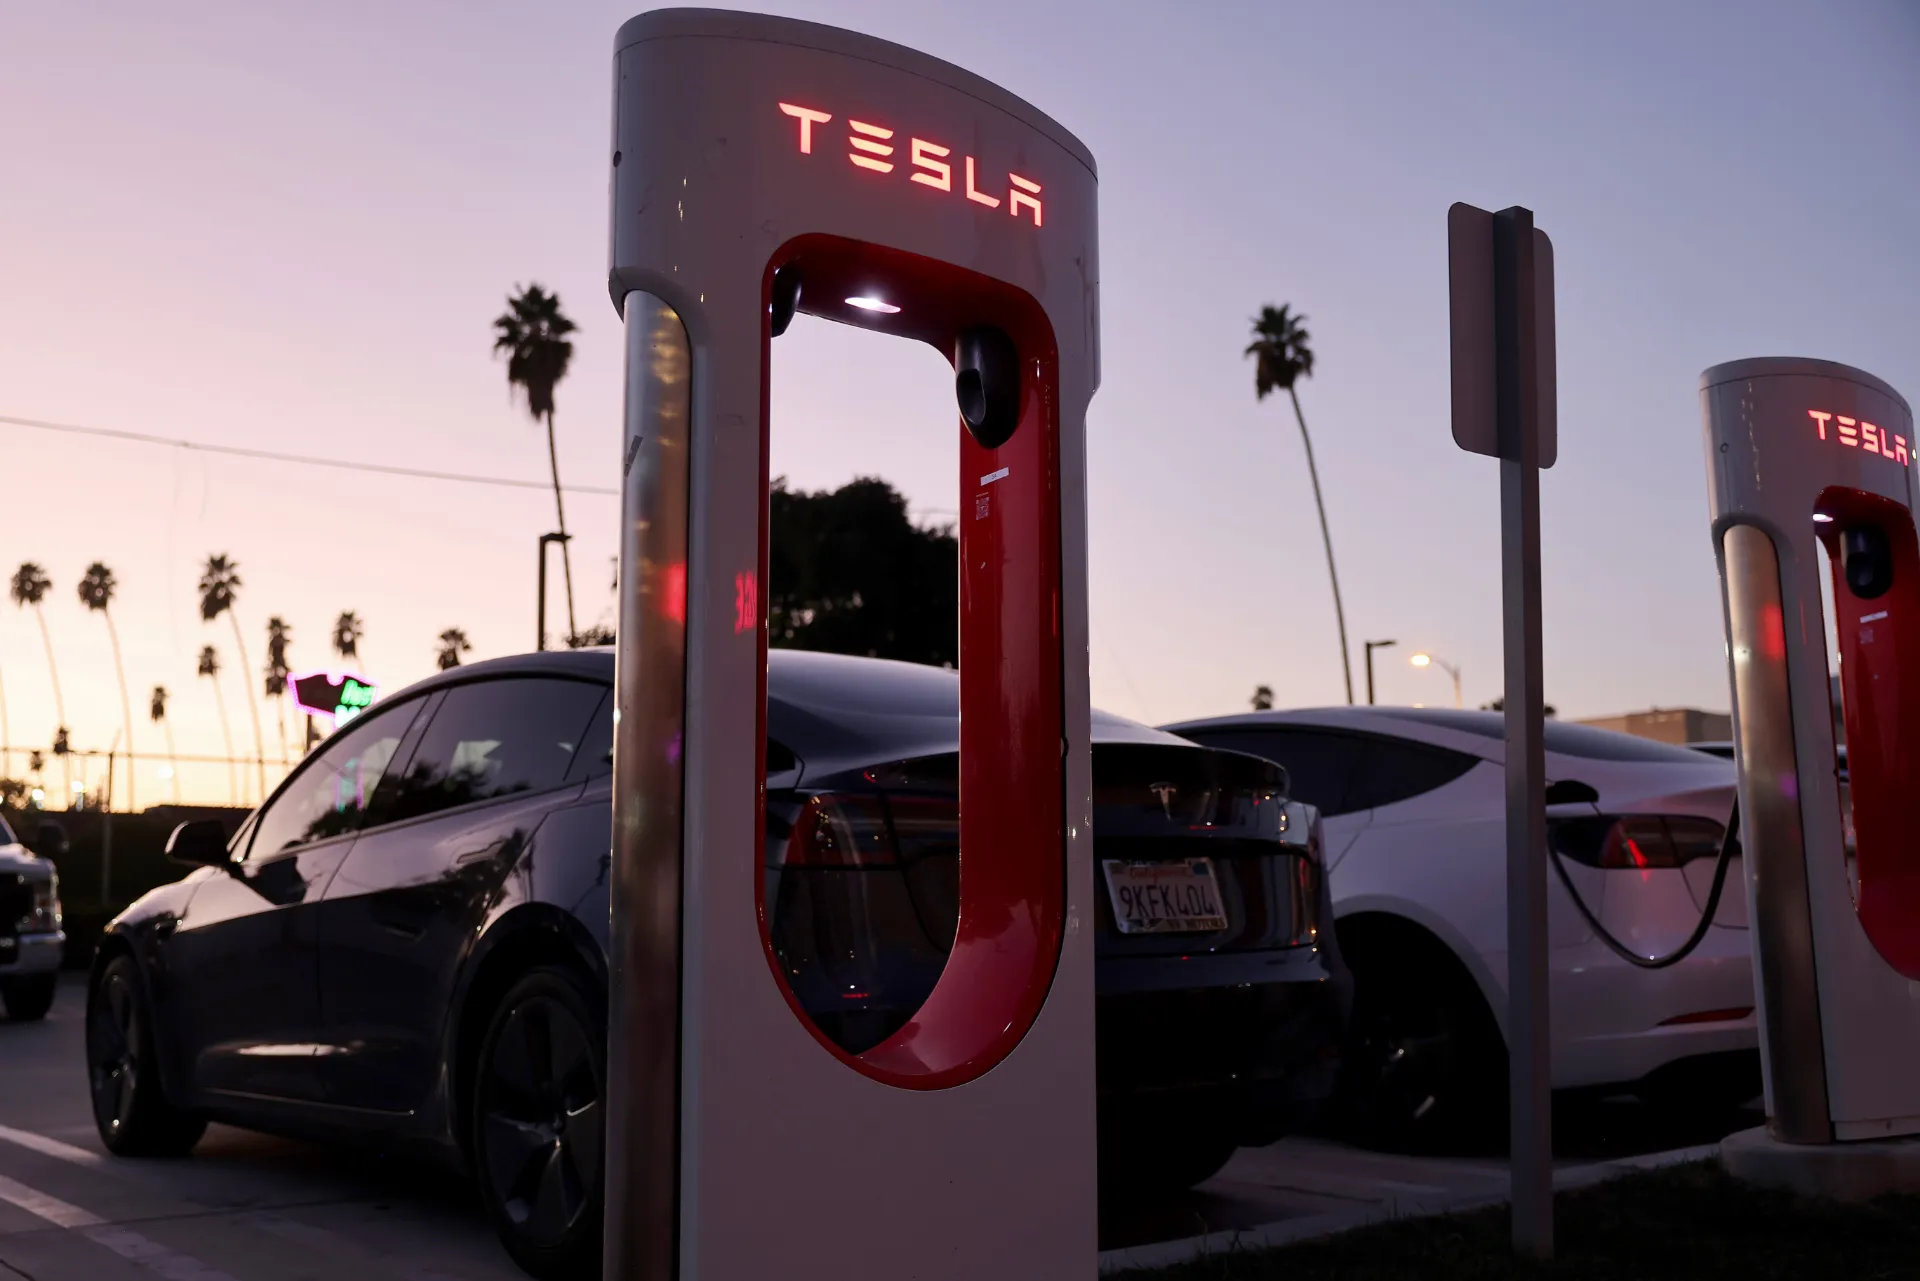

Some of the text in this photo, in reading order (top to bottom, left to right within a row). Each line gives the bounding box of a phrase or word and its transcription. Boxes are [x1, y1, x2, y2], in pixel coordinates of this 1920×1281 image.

[778, 102, 1042, 227] TESLA
[1808, 409, 1908, 466] TESLA
[1119, 885, 1215, 918] 9KFK404
